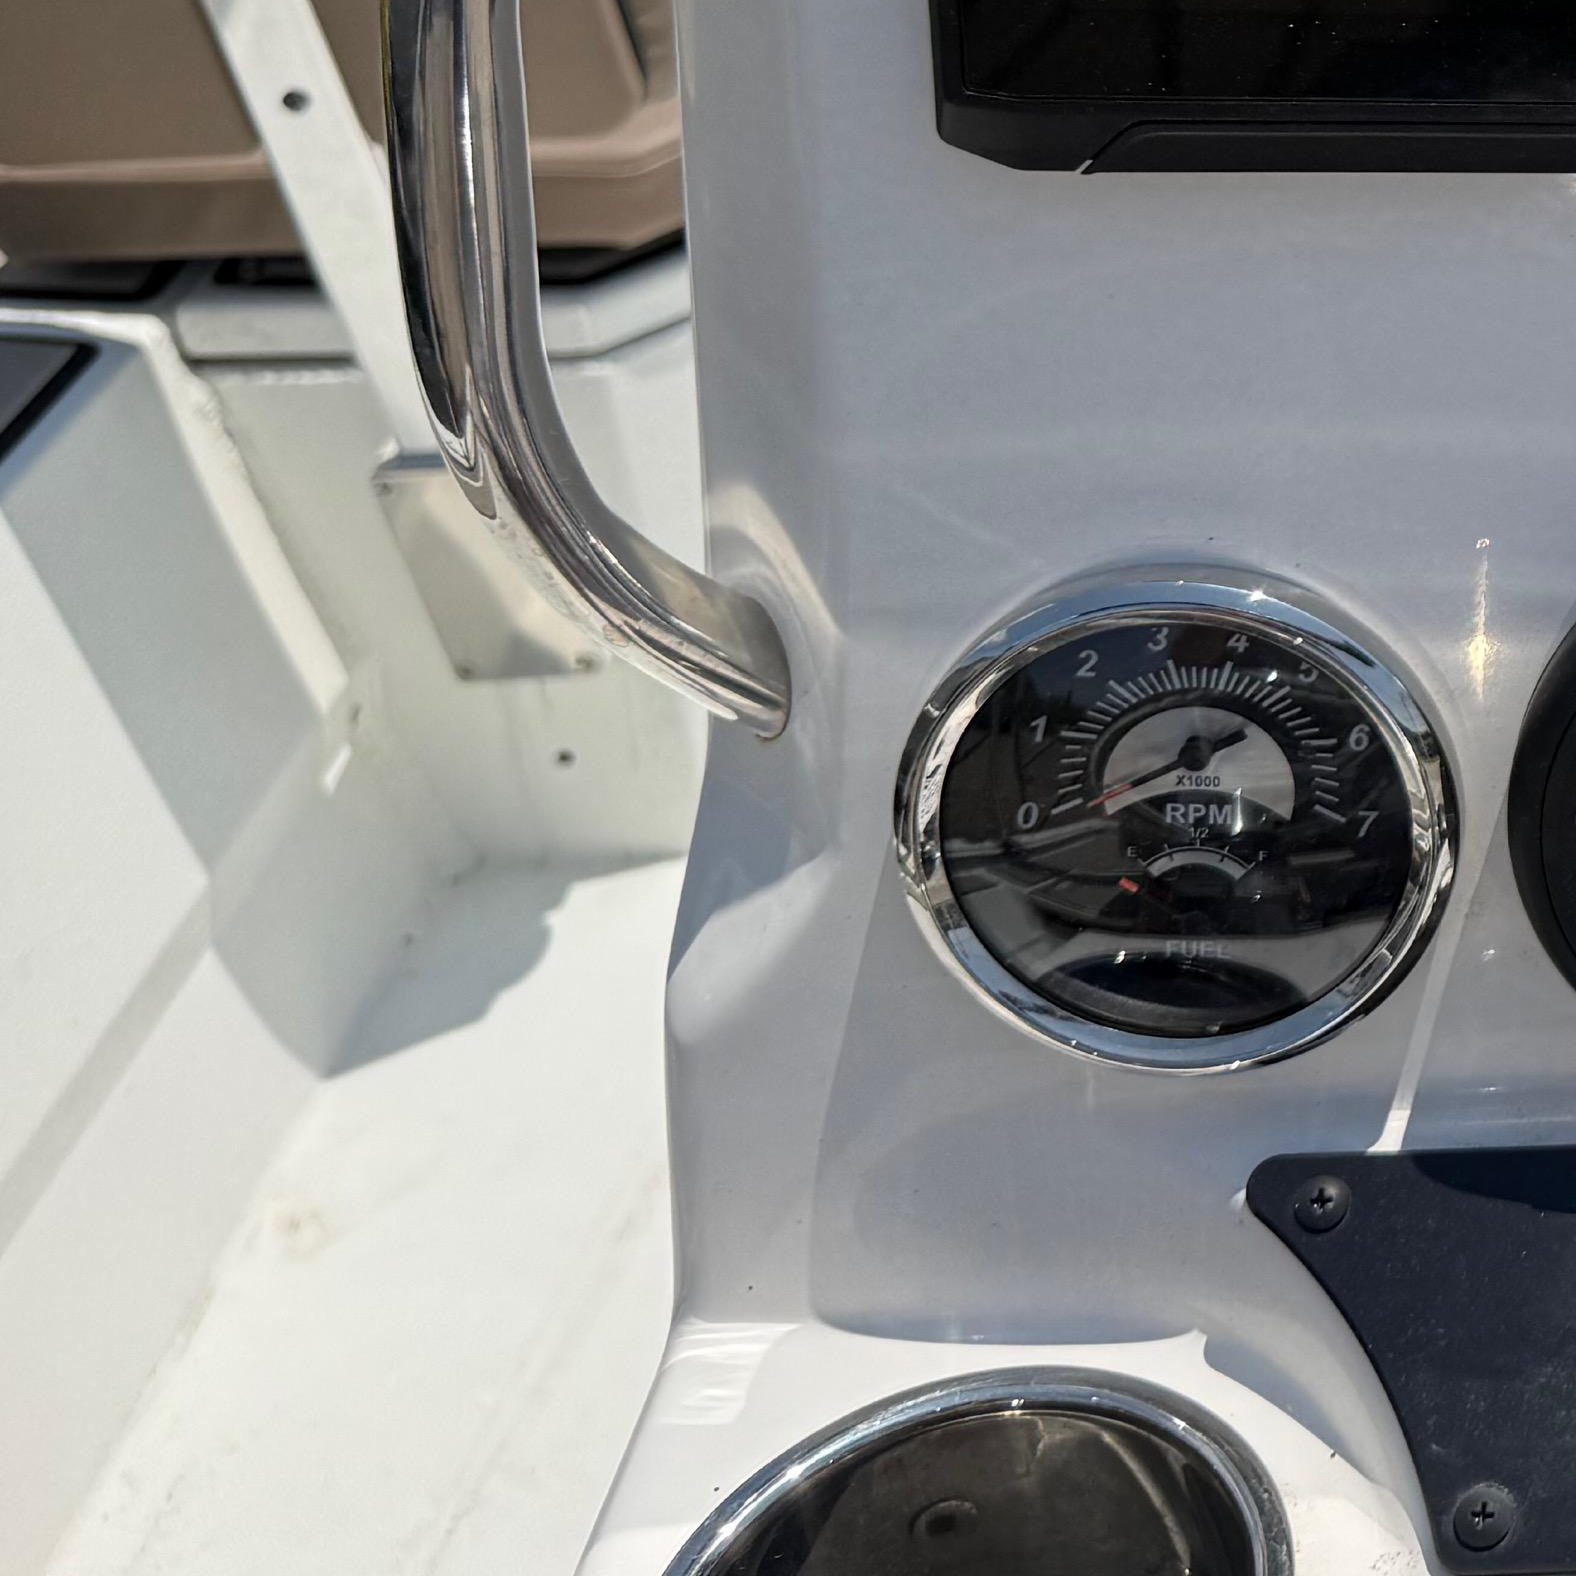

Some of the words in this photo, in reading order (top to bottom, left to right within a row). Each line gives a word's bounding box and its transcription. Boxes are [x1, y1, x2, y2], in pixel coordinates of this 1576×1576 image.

[1148, 627, 1169, 652] 3
[1228, 632, 1250, 652] 4
[1076, 651, 1098, 678] 2
[1031, 717, 1047, 743] 1
[1350, 724, 1370, 751] 6
[1175, 774, 1221, 787] X1000
[1017, 802, 1039, 828] 0
[1166, 803, 1232, 825] RPM
[1357, 810, 1379, 837] 7
[1188, 827, 1209, 838] 1/2
[1127, 845, 1137, 858] E
[1259, 850, 1269, 861] F
[1166, 940, 1231, 959] FUEL
